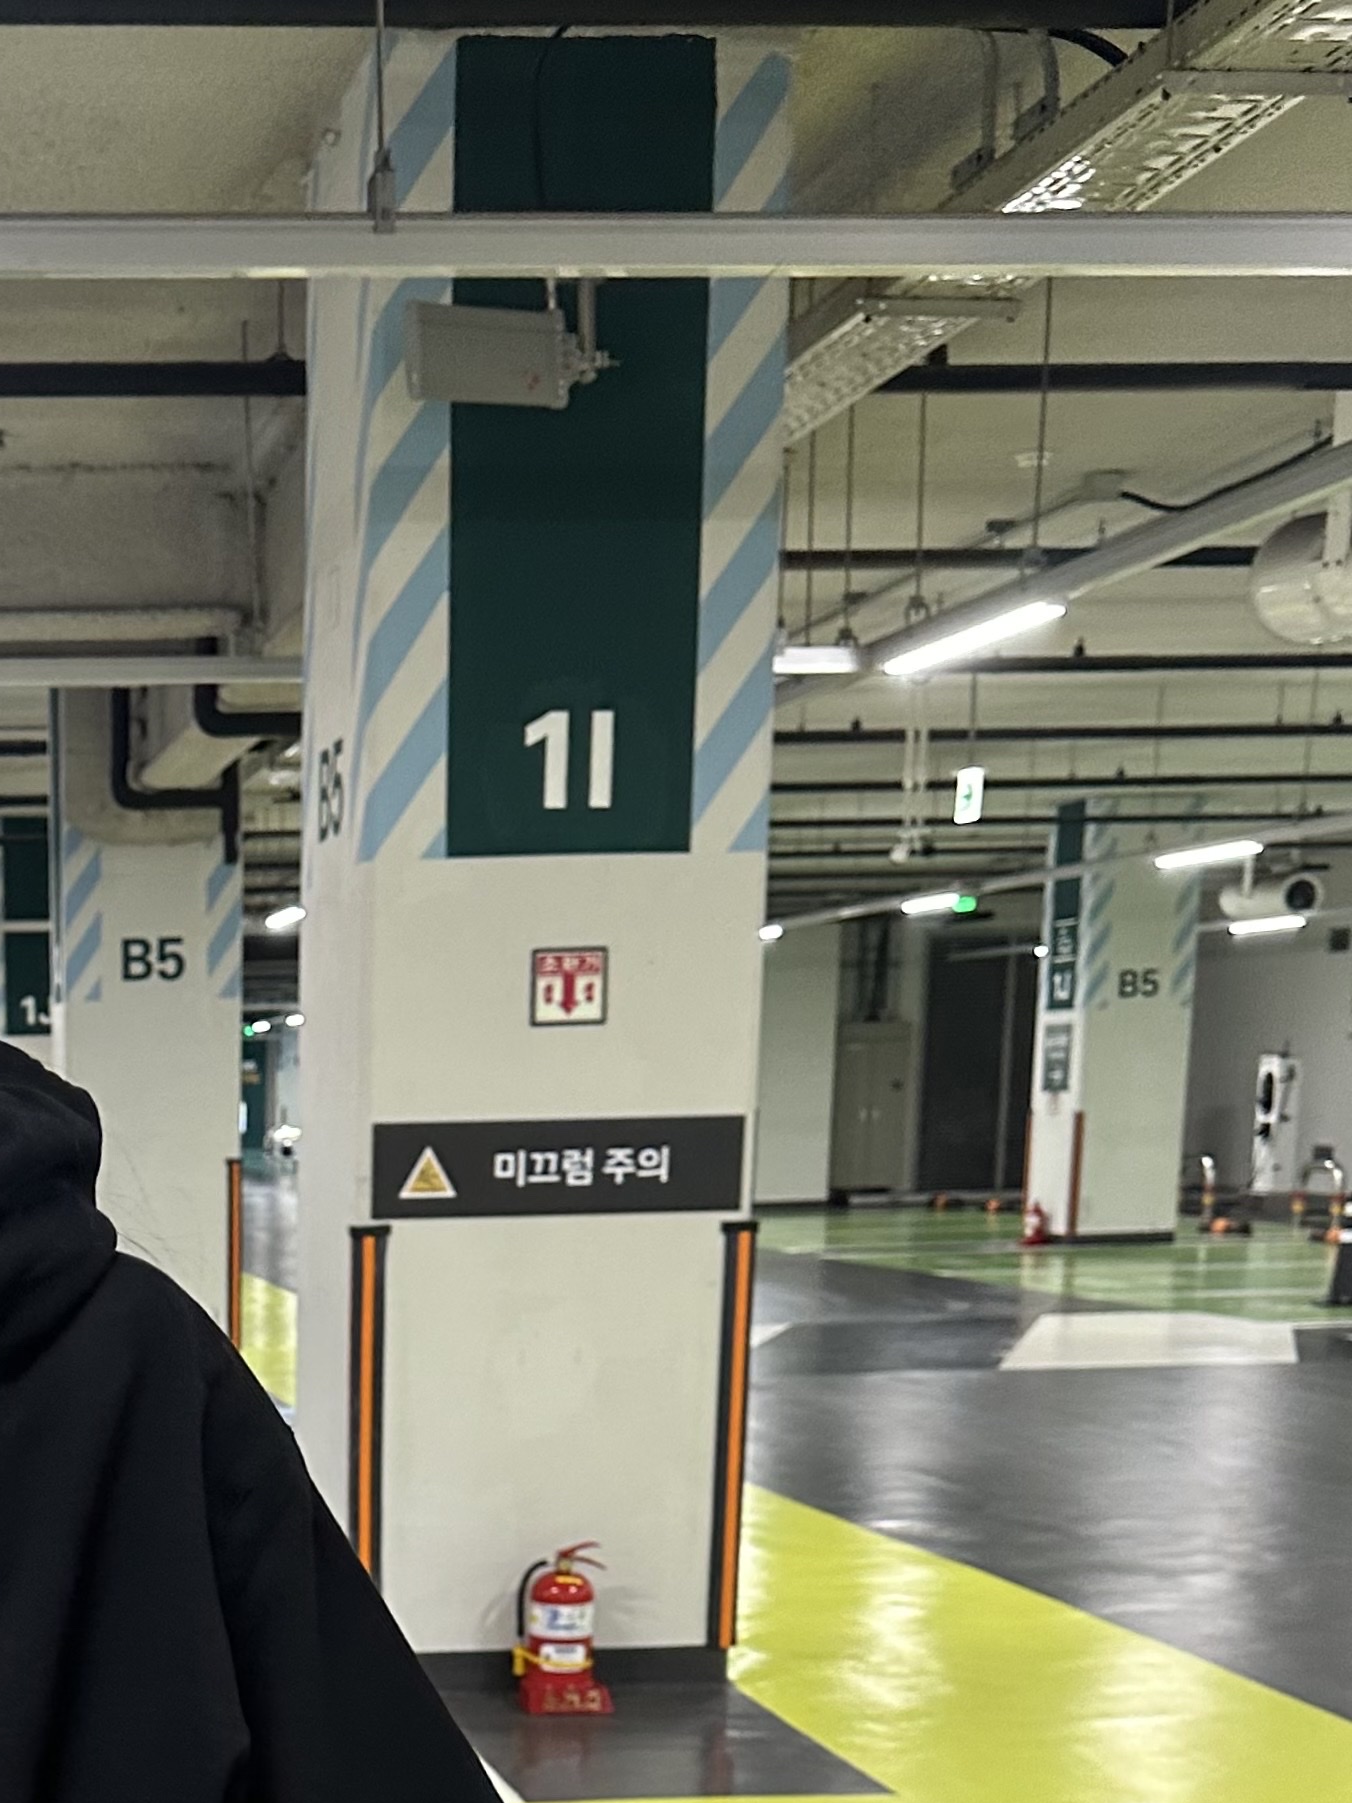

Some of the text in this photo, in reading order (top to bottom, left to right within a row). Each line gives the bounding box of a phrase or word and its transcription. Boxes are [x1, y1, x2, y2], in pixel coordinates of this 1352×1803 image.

[318, 738, 345, 843] B5
[121, 937, 187, 983] B5
[1118, 966, 1160, 998] B5
[493, 1144, 671, 1188] 미끄럼 주의
